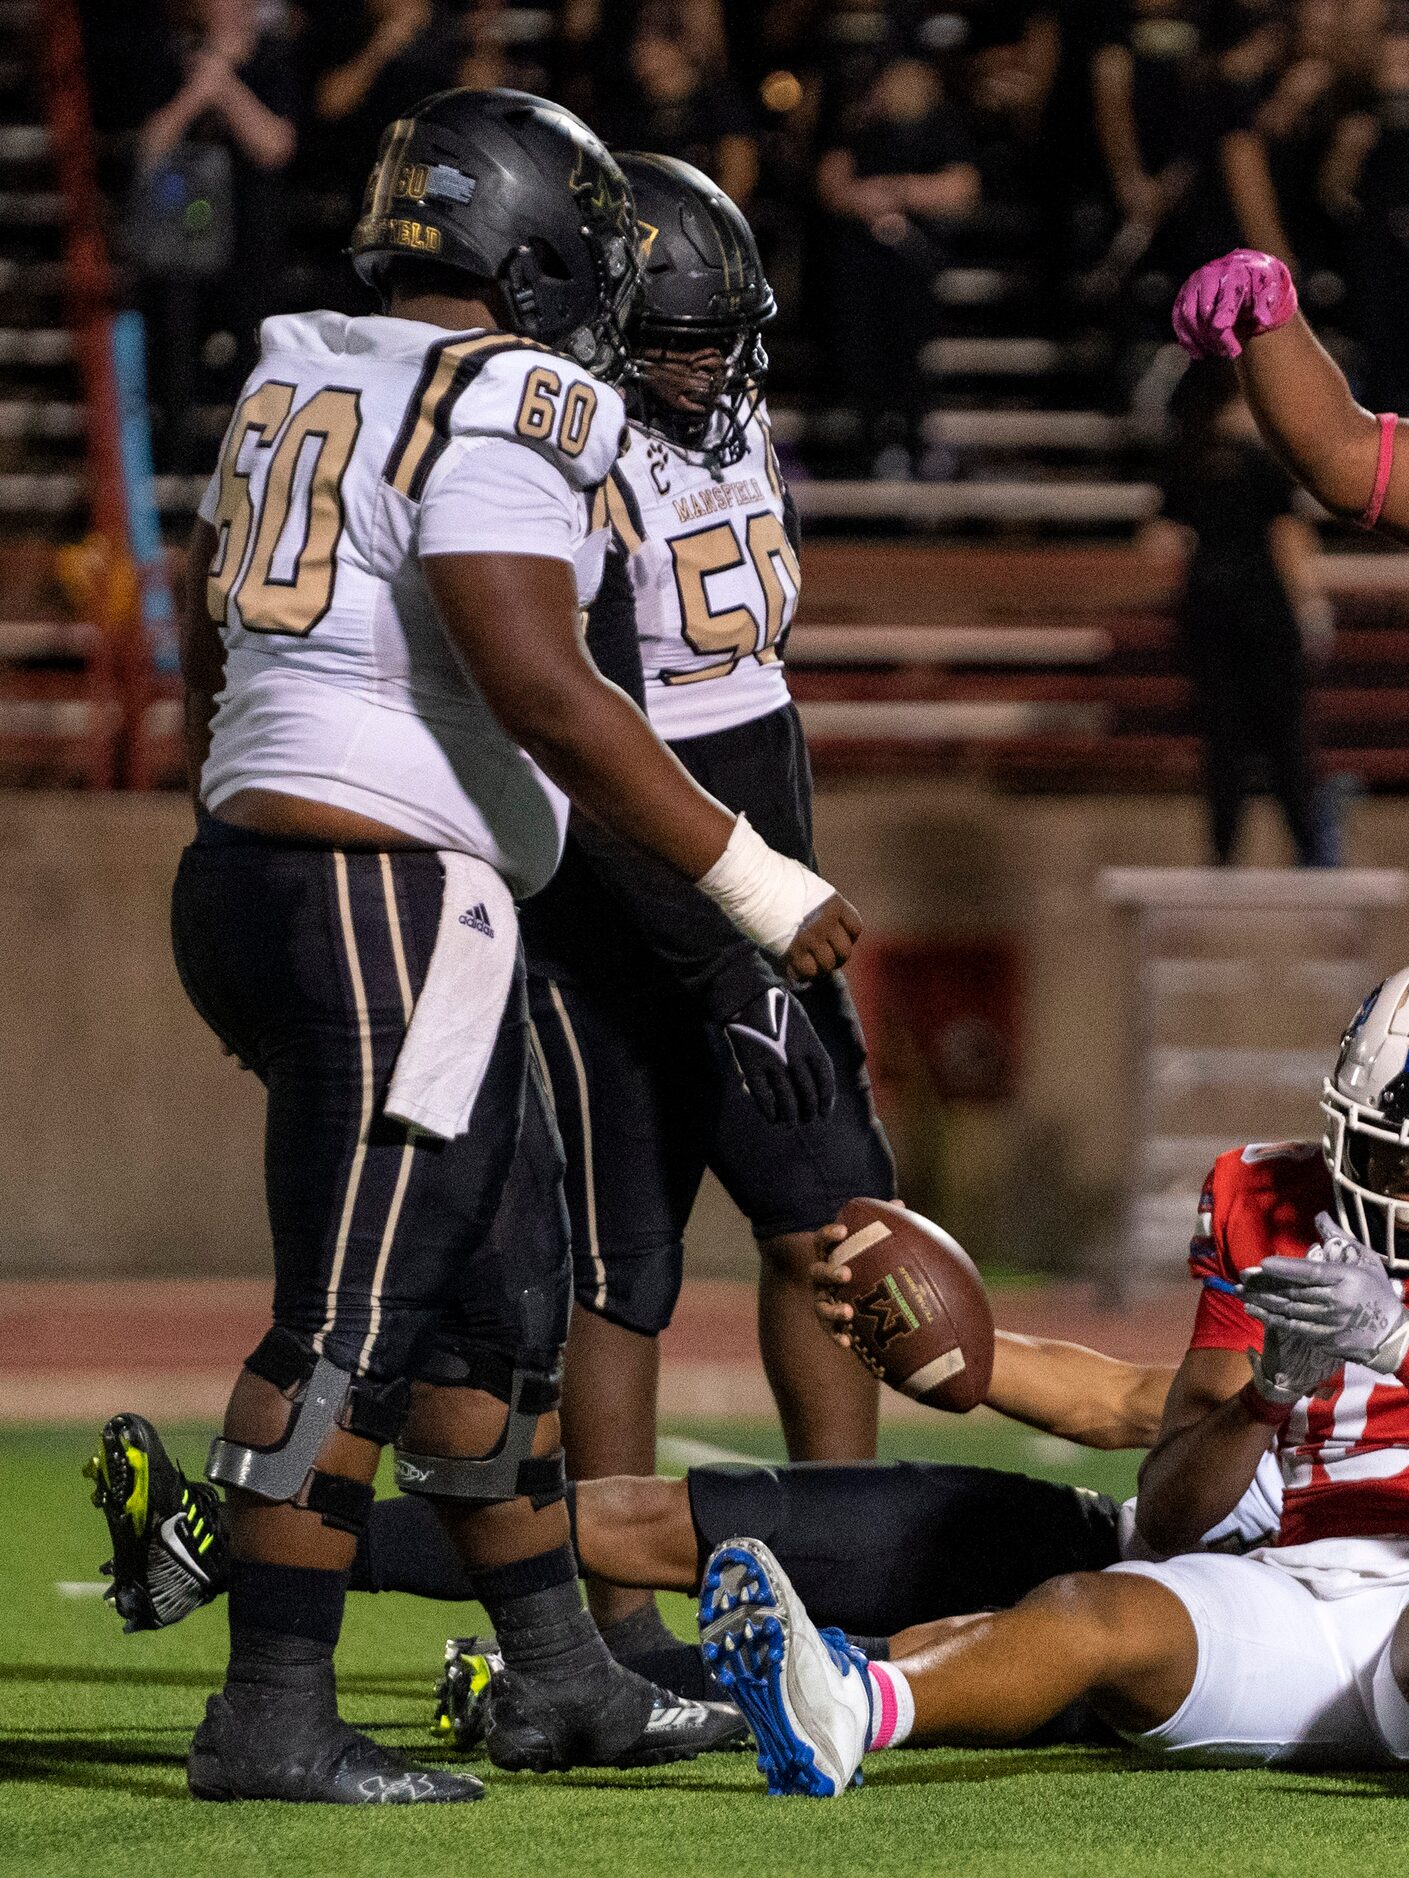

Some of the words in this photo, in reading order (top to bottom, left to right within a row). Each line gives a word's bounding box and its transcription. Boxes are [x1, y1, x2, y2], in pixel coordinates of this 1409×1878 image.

[513, 365, 598, 458] 60
[205, 379, 363, 638] 60
[650, 460, 671, 496] C
[659, 508, 801, 686] 50
[458, 913, 495, 938] adidas
